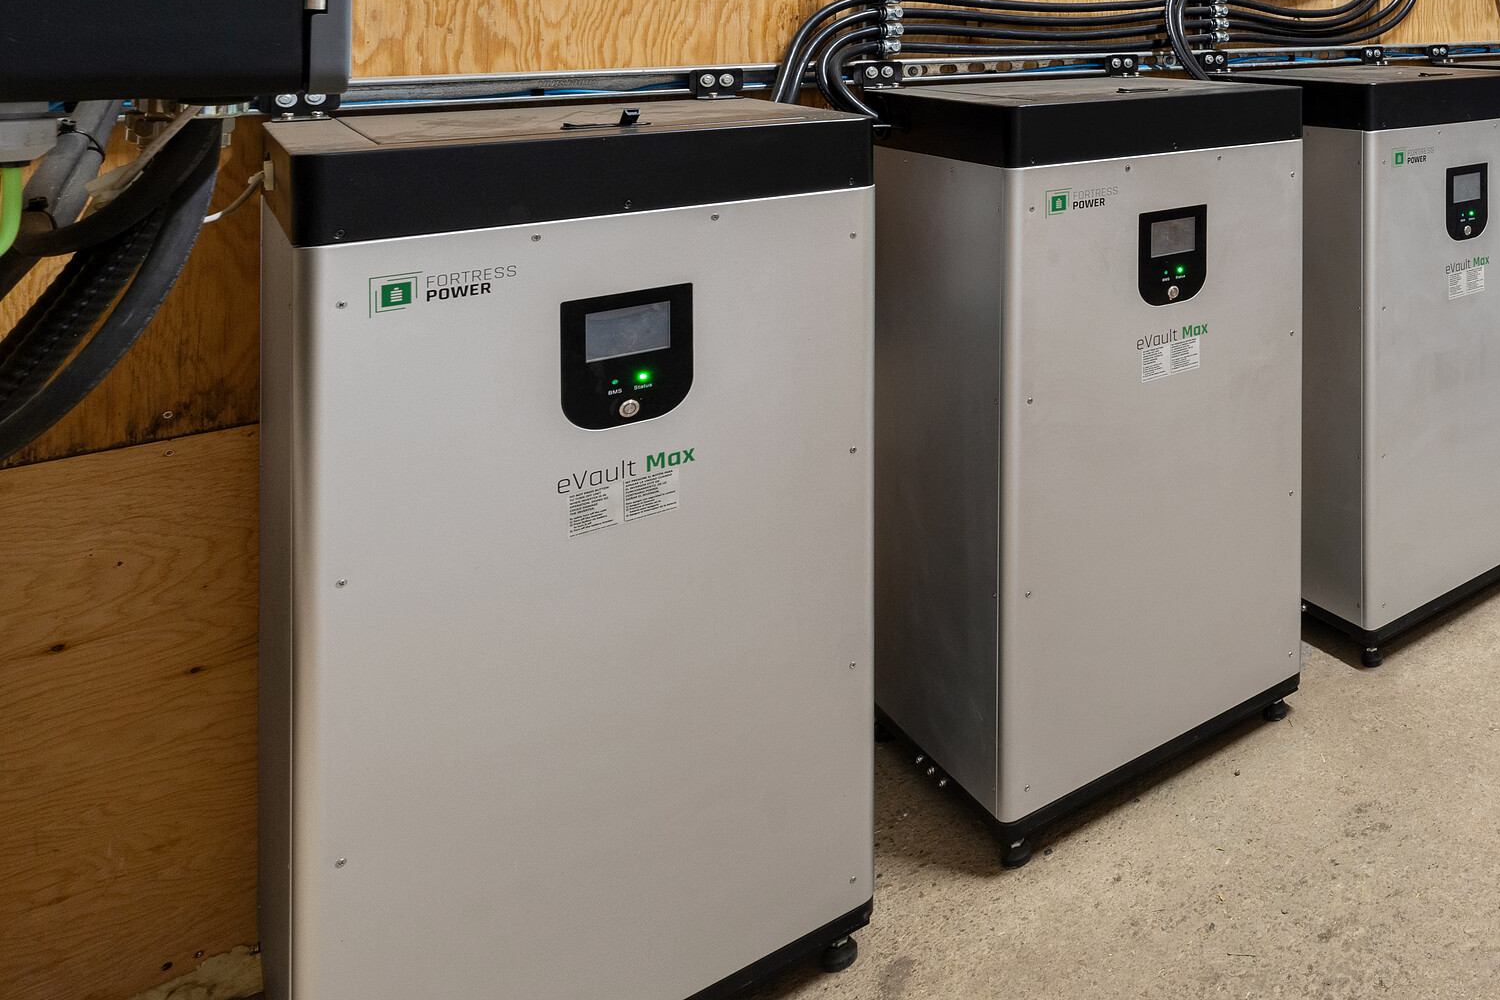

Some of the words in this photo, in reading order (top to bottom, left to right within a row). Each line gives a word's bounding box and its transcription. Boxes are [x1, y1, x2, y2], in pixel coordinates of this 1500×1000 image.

[1407, 155, 1427, 164] POWER
[1073, 186, 1119, 200] FORTRESS
[1072, 197, 1106, 210] POWER
[1445, 259, 1471, 274] eVault
[1473, 256, 1490, 267] Max
[426, 265, 517, 288] FORTRESS
[426, 282, 491, 302] POWER
[1136, 329, 1178, 351] eVault
[1182, 323, 1208, 339] Max
[607, 388, 623, 396] BMS
[557, 460, 637, 494] eVault
[646, 447, 695, 473] Max
